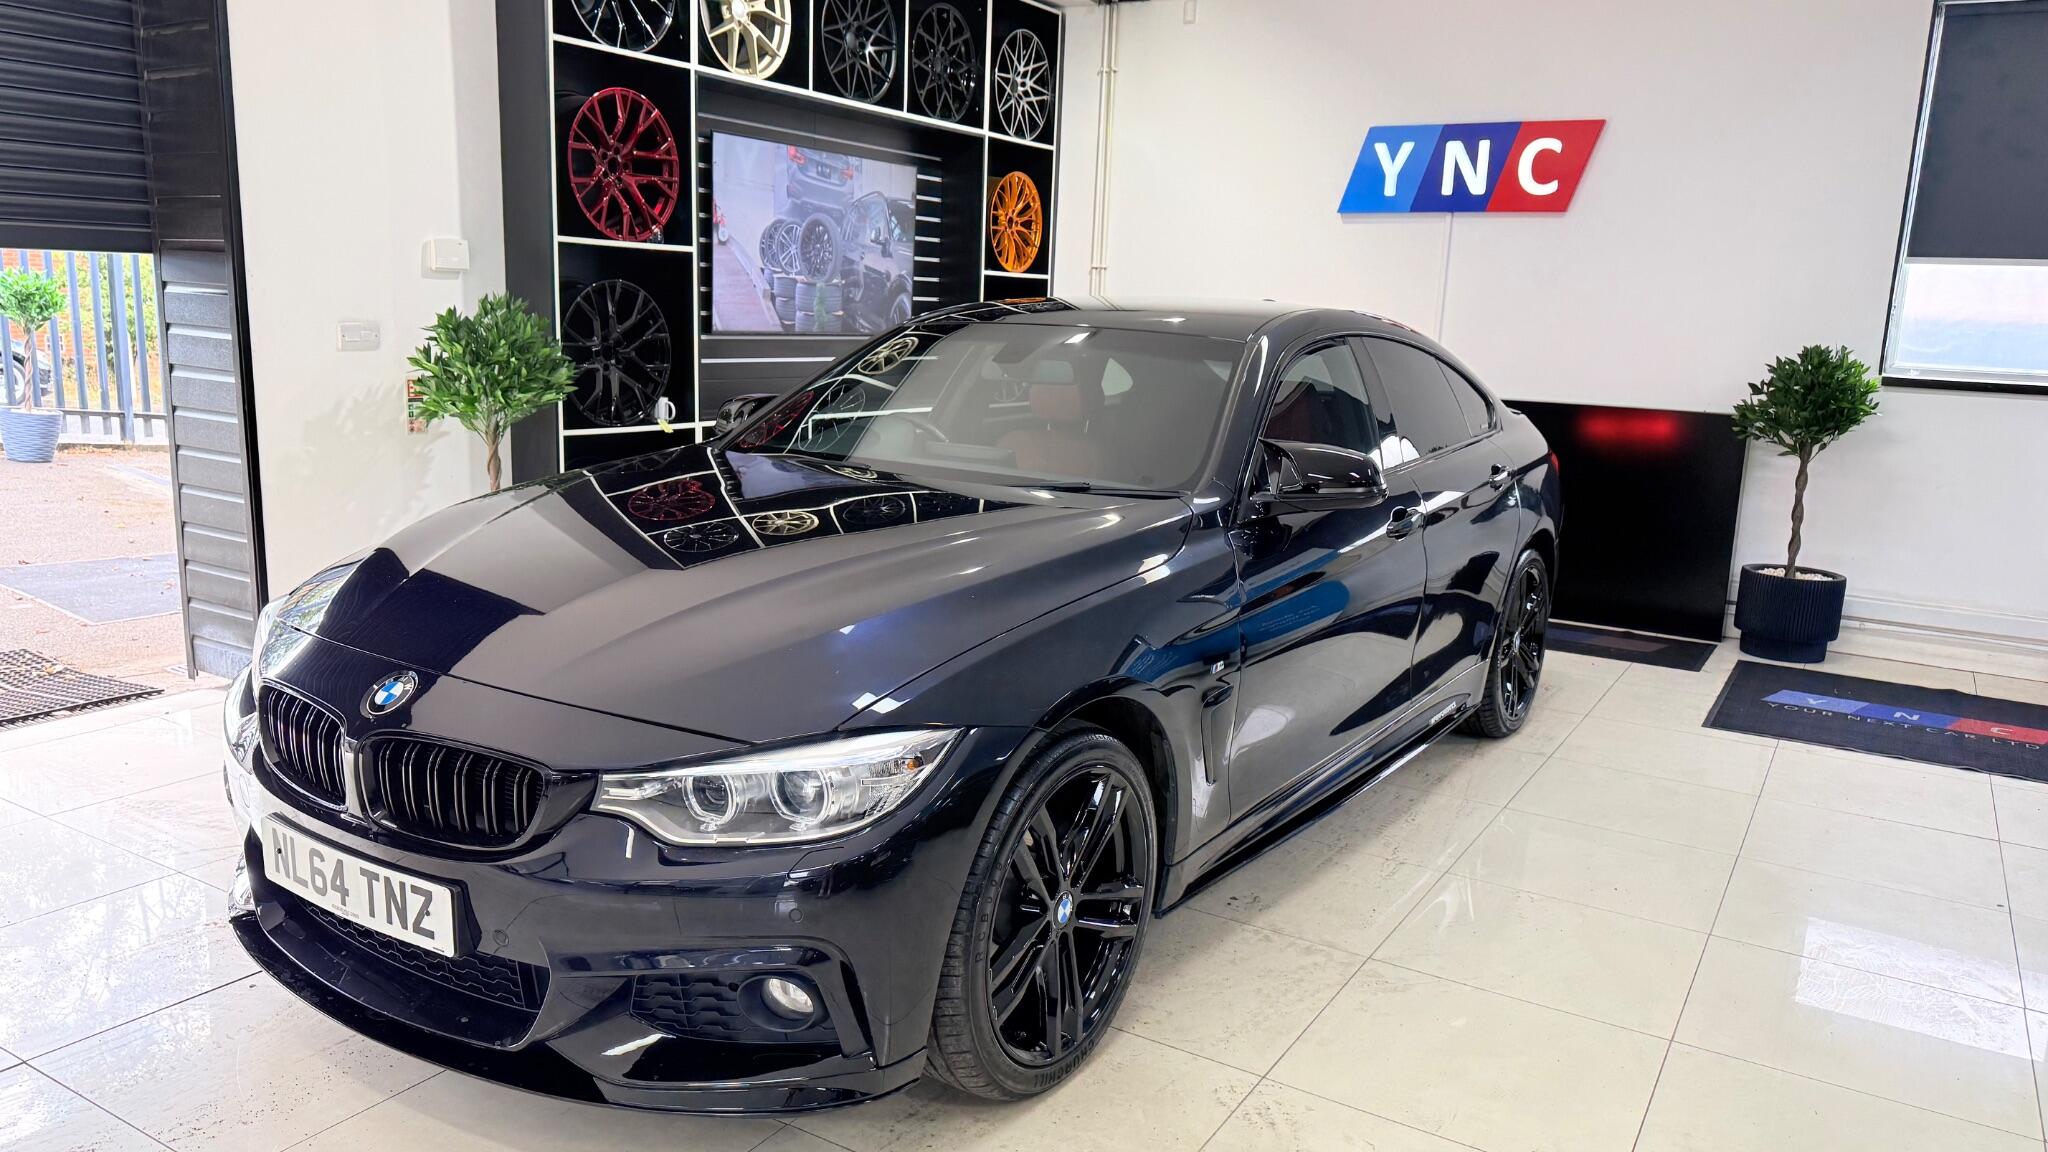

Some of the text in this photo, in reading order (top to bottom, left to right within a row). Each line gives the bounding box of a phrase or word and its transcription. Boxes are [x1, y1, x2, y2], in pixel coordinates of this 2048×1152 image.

[1374, 137, 1563, 197] YNC
[1767, 702, 2041, 750] YOUR NEXT CAR LTD
[1806, 697, 2014, 735] YNC
[272, 828, 435, 940] NL64 TNZ
